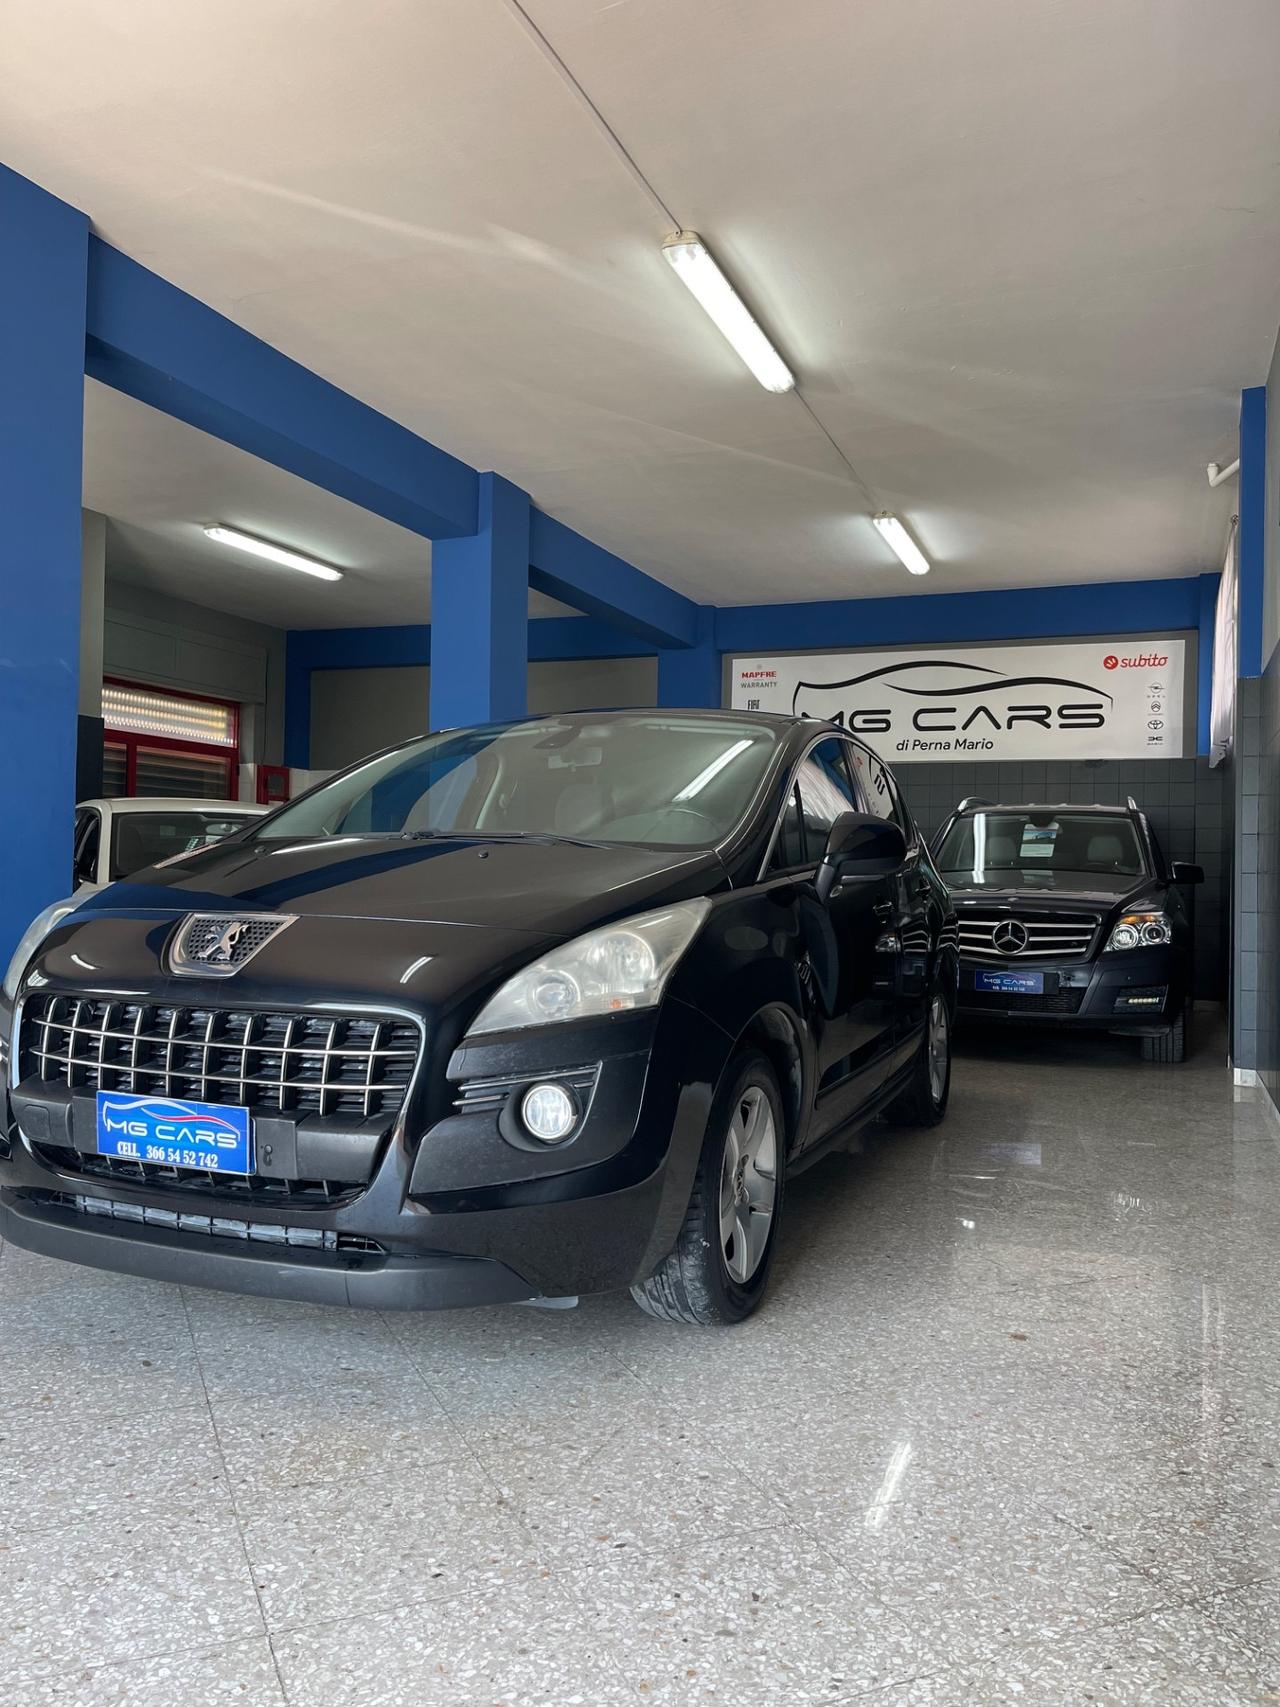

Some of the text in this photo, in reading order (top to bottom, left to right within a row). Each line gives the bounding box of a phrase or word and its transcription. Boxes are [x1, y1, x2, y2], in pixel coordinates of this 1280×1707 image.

[1120, 653, 1169, 668] subito
[741, 671, 777, 679] MAPFRE
[740, 681, 777, 689] WARRANTY
[912, 703, 1106, 732] CARS
[896, 738, 994, 751] di Perna Mario
[106, 1118, 238, 1149] MG CARS
[117, 1141, 219, 1168] CELL. 366 54 52 742
